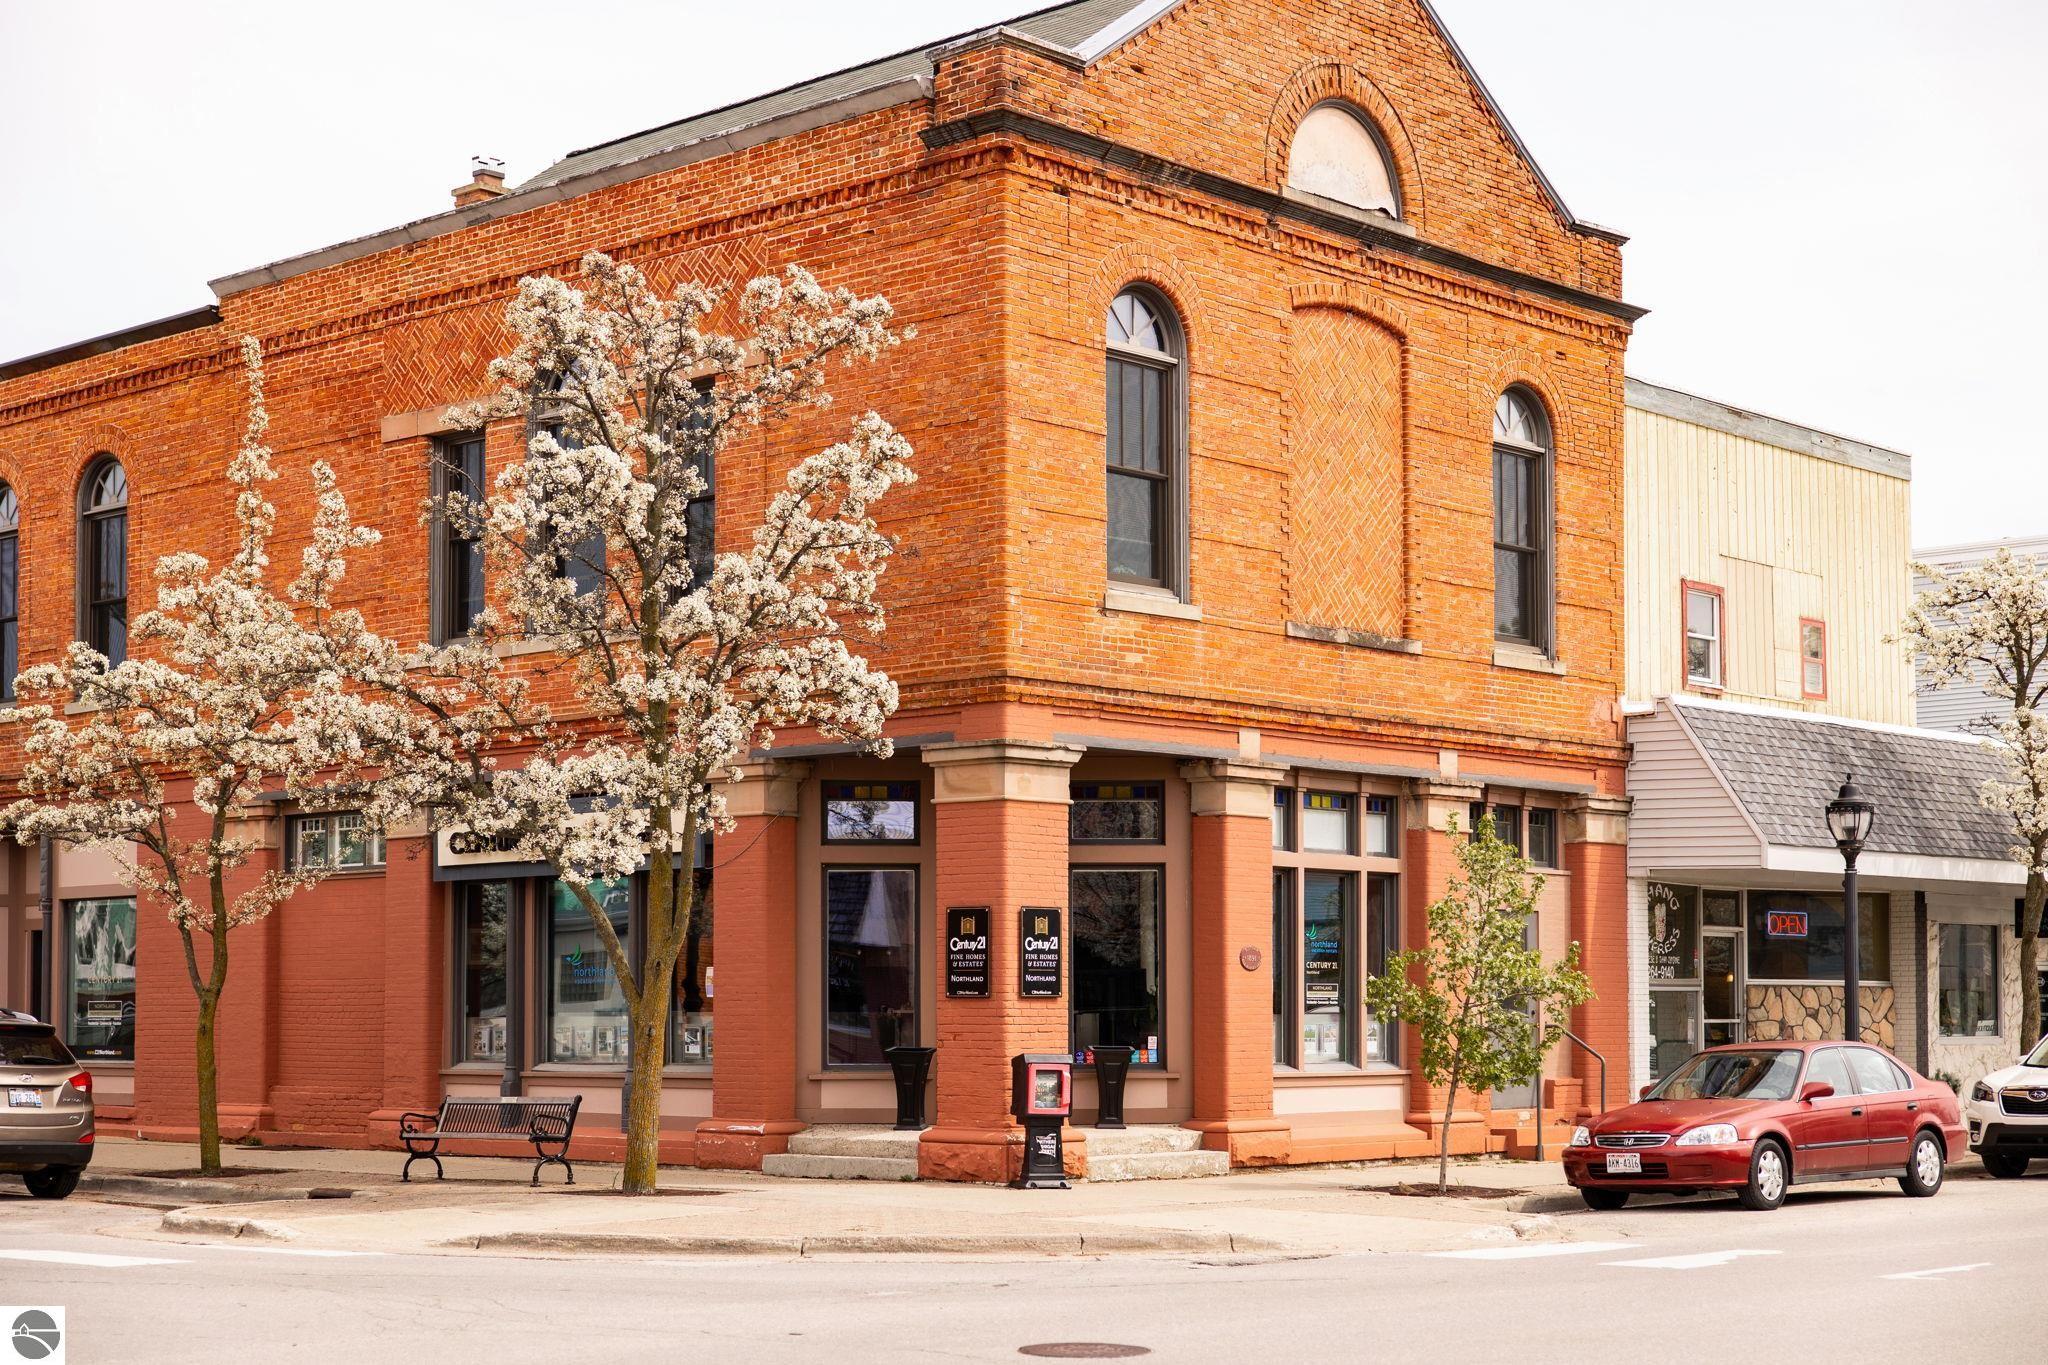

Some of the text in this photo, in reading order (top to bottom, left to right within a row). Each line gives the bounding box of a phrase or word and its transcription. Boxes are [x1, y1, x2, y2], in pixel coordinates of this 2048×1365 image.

[1769, 914, 1806, 934] OPEN
[1306, 961, 1331, 969] CENTURY
[88, 976, 115, 984] CENTURY
